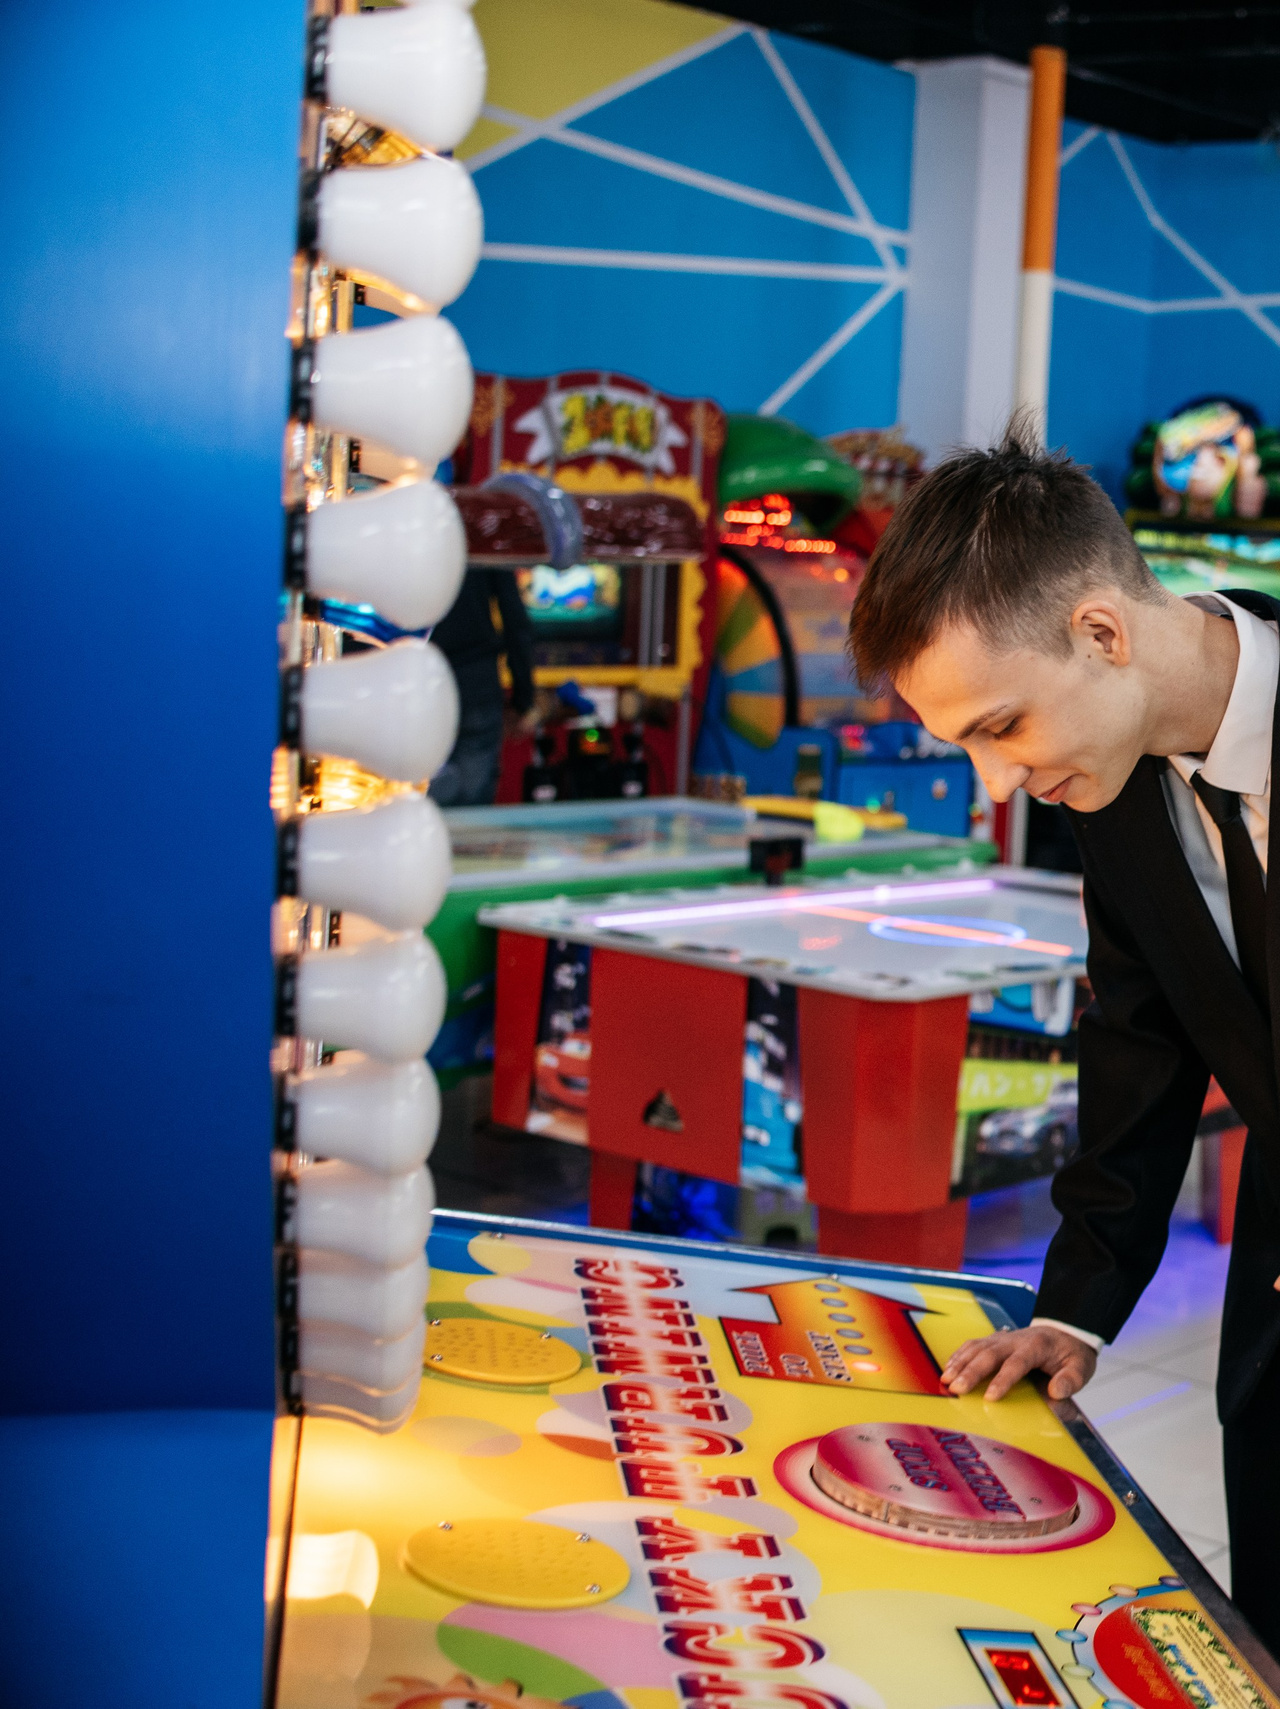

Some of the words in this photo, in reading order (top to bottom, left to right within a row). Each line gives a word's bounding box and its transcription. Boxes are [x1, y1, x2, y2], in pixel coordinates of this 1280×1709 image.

[573, 1257, 759, 1500] TURNING
[731, 1329, 775, 1377] PULL
[779, 1352, 814, 1379] TO
[806, 1330, 853, 1383] START
[886, 1438, 950, 1491] STOP
[929, 1427, 1026, 1521] BUTTON
